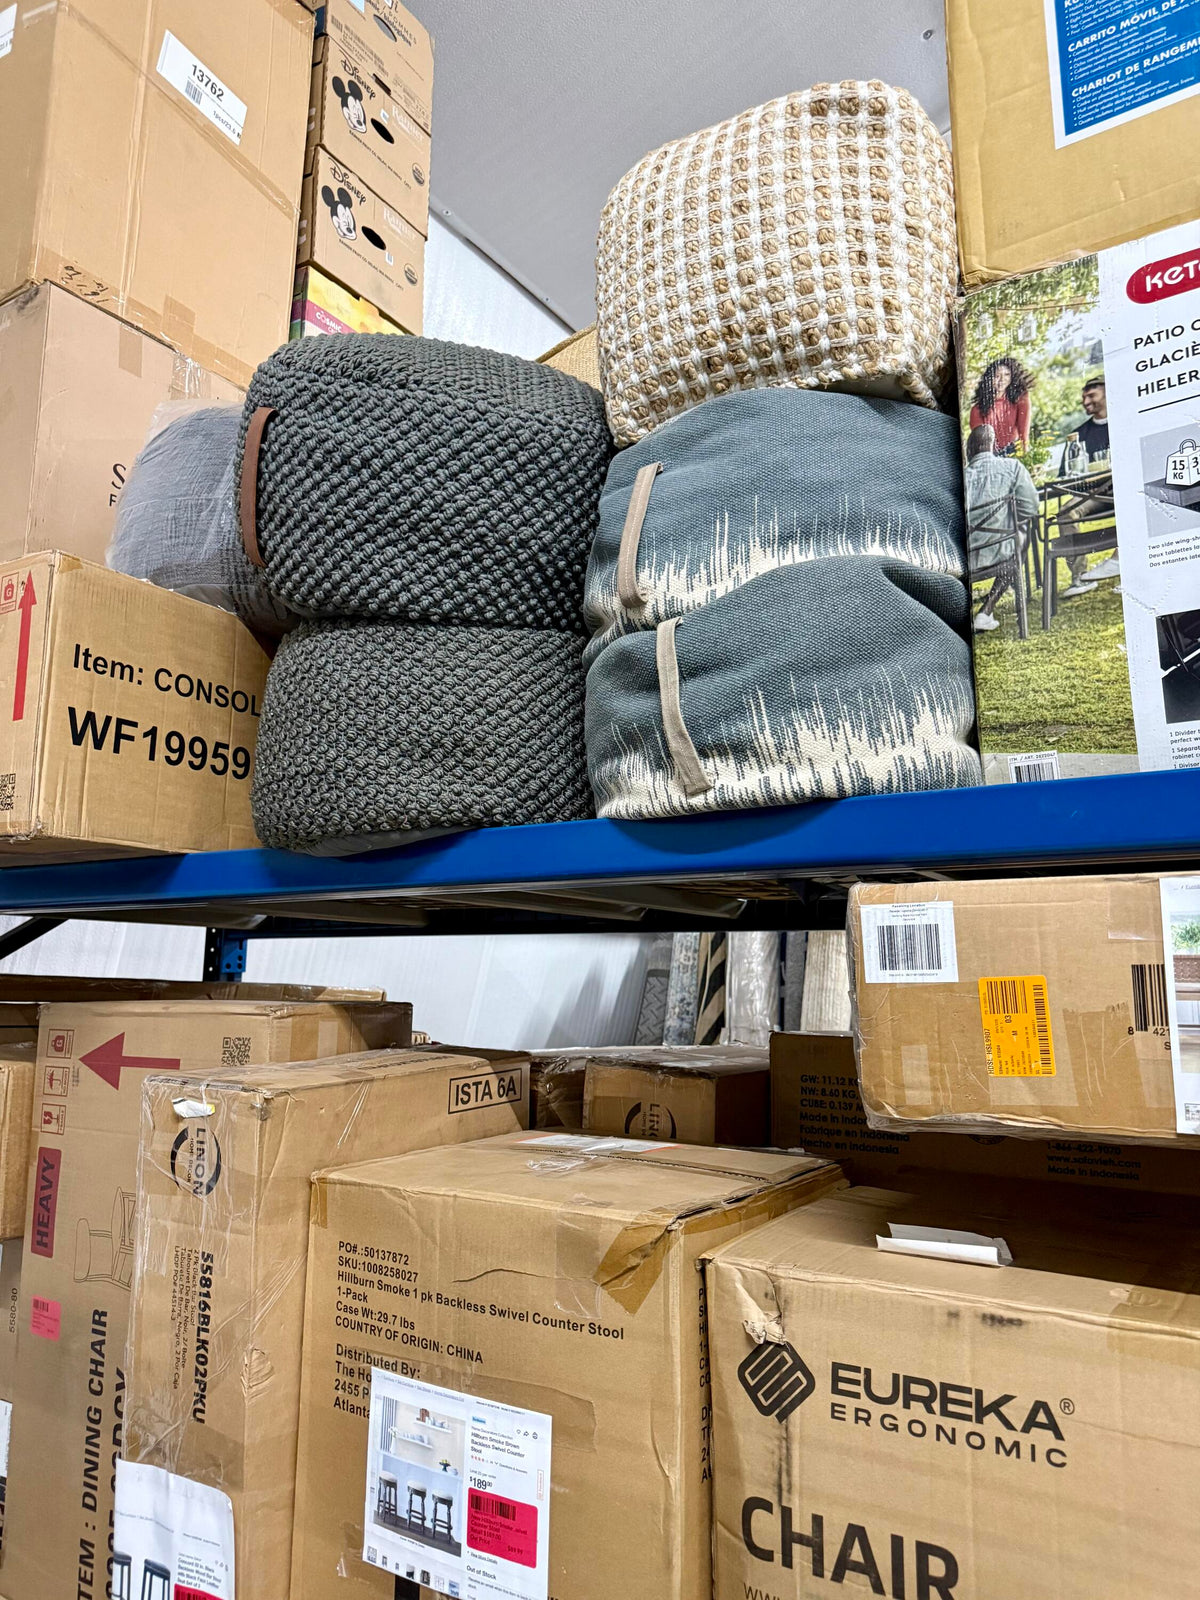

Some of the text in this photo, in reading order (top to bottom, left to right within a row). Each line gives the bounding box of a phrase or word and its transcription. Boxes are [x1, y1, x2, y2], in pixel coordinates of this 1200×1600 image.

[1068, 25, 1116, 52] CARRITO
[1119, 6, 1159, 30] MÓVIL
[1161, 0, 1177, 12] DE
[191, 63, 224, 102] 13762
[1071, 70, 1122, 97] CHARIOT
[1125, 62, 1140, 76] DE
[1145, 259, 1200, 292] KET
[315, 311, 342, 332] COSMIC
[1133, 325, 1185, 350] PATIO
[1171, 459, 1185, 471] 15
[1173, 472, 1184, 480] KG
[1148, 543, 1160, 551] Two
[1161, 540, 1174, 548] side
[1148, 551, 1163, 559] Deux
[1165, 546, 1192, 556] tablettes
[1162, 556, 1188, 565] estantes
[73, 643, 261, 717] Item: CONSOL
[67, 705, 251, 780] WF19959
[1170, 737, 1192, 745] perfect
[1174, 729, 1196, 737] Divider
[1127, 1026, 1134, 1035] 8
[800, 1074, 820, 1084] GW:
[822, 1075, 846, 1086] 11.12
[455, 1075, 517, 1106] ISTA 6A
[800, 1086, 819, 1096] NW:
[820, 1088, 840, 1098] 8.60
[828, 1100, 854, 1111] 0.139
[800, 1111, 828, 1121] Made
[800, 1124, 842, 1138] Fabrique
[845, 1129, 858, 1138] en
[800, 1137, 832, 1148] Hecho
[834, 1141, 848, 1150] en
[192, 1127, 206, 1195] LINON
[1047, 1155, 1141, 1169] www.safavieh.com
[1047, 1165, 1076, 1175] Made
[36, 1156, 55, 1249] HEAVY
[193, 1256, 199, 1266] Pk
[338, 1240, 409, 1266] PO#.:50137872
[337, 1255, 419, 1283] SKU:1008258027
[179, 1284, 185, 1296] De
[185, 1285, 191, 1296] De
[337, 1286, 368, 1303] 1-Pack
[9, 1287, 18, 1333] 5580-80
[337, 1270, 624, 1340] Hillburn Smoke 1 pk Backless Swivel Counter Stool
[336, 1300, 415, 1331] Case Wt:29.7 lbs
[193, 1251, 214, 1424] 55816BLK02PKU
[335, 1315, 484, 1364] COUNTRY OF ORIGIN: CHINA
[88, 1308, 108, 1397] CHAIR
[336, 1343, 421, 1379] Distributed By:
[335, 1360, 355, 1378] The
[334, 1378, 359, 1397] 2455
[831, 1361, 1065, 1441] EUREKA
[830, 1401, 1067, 1468] ERGONOMIC
[505, 1440, 520, 1449] Brown
[506, 1448, 525, 1458] Counter
[81, 1404, 102, 1513] DINING
[741, 1495, 959, 1600] CHAIR
[466, 1565, 475, 1573] Out
[482, 1570, 496, 1580] Stock
